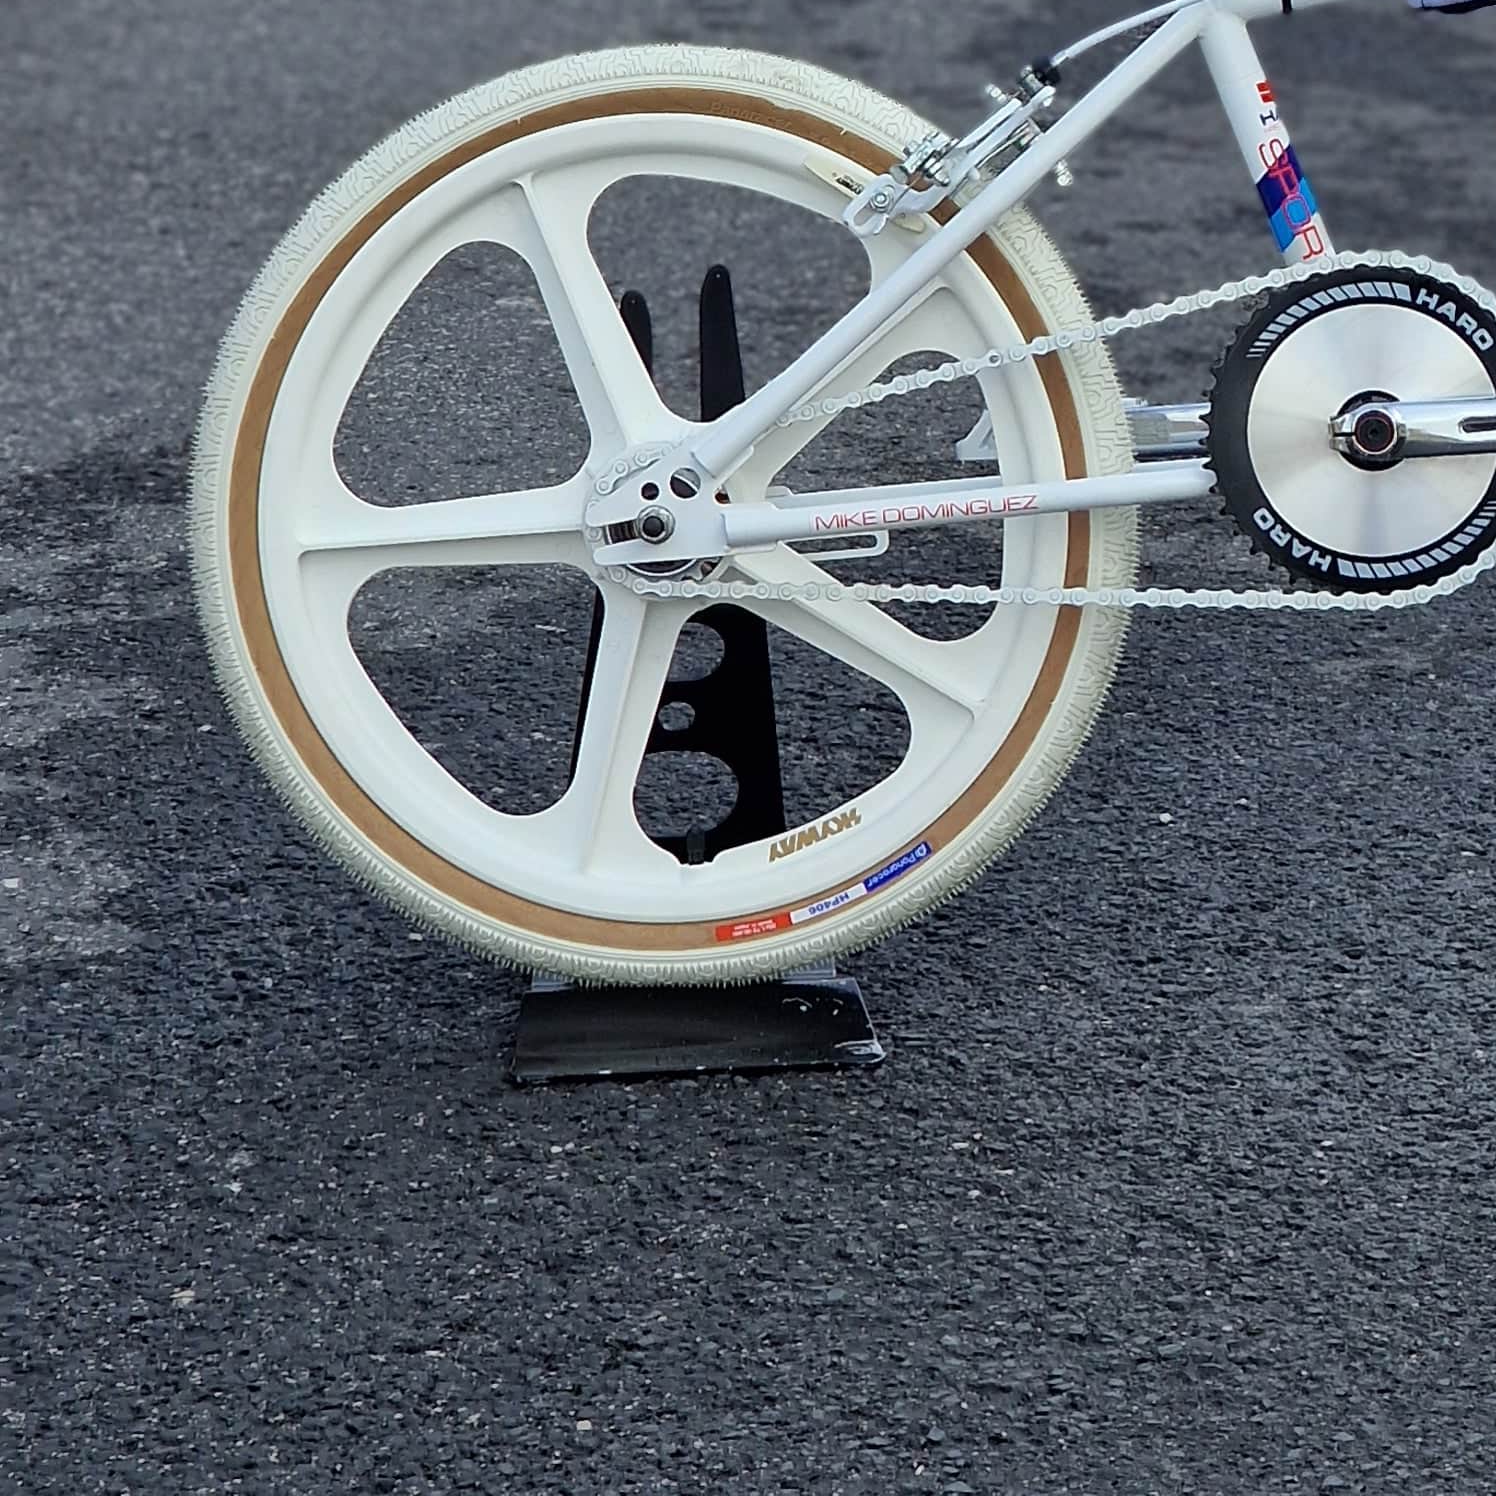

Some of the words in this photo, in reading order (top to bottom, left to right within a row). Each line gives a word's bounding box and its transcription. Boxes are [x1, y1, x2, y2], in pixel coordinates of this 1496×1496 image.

[1416, 287, 1495, 352] HARO
[815, 510, 877, 531] MIKE
[882, 495, 1039, 525] DOMINGUEZ
[1252, 506, 1333, 573] HARO
[768, 807, 863, 863] SKYWAY
[807, 892, 850, 916] HP406
